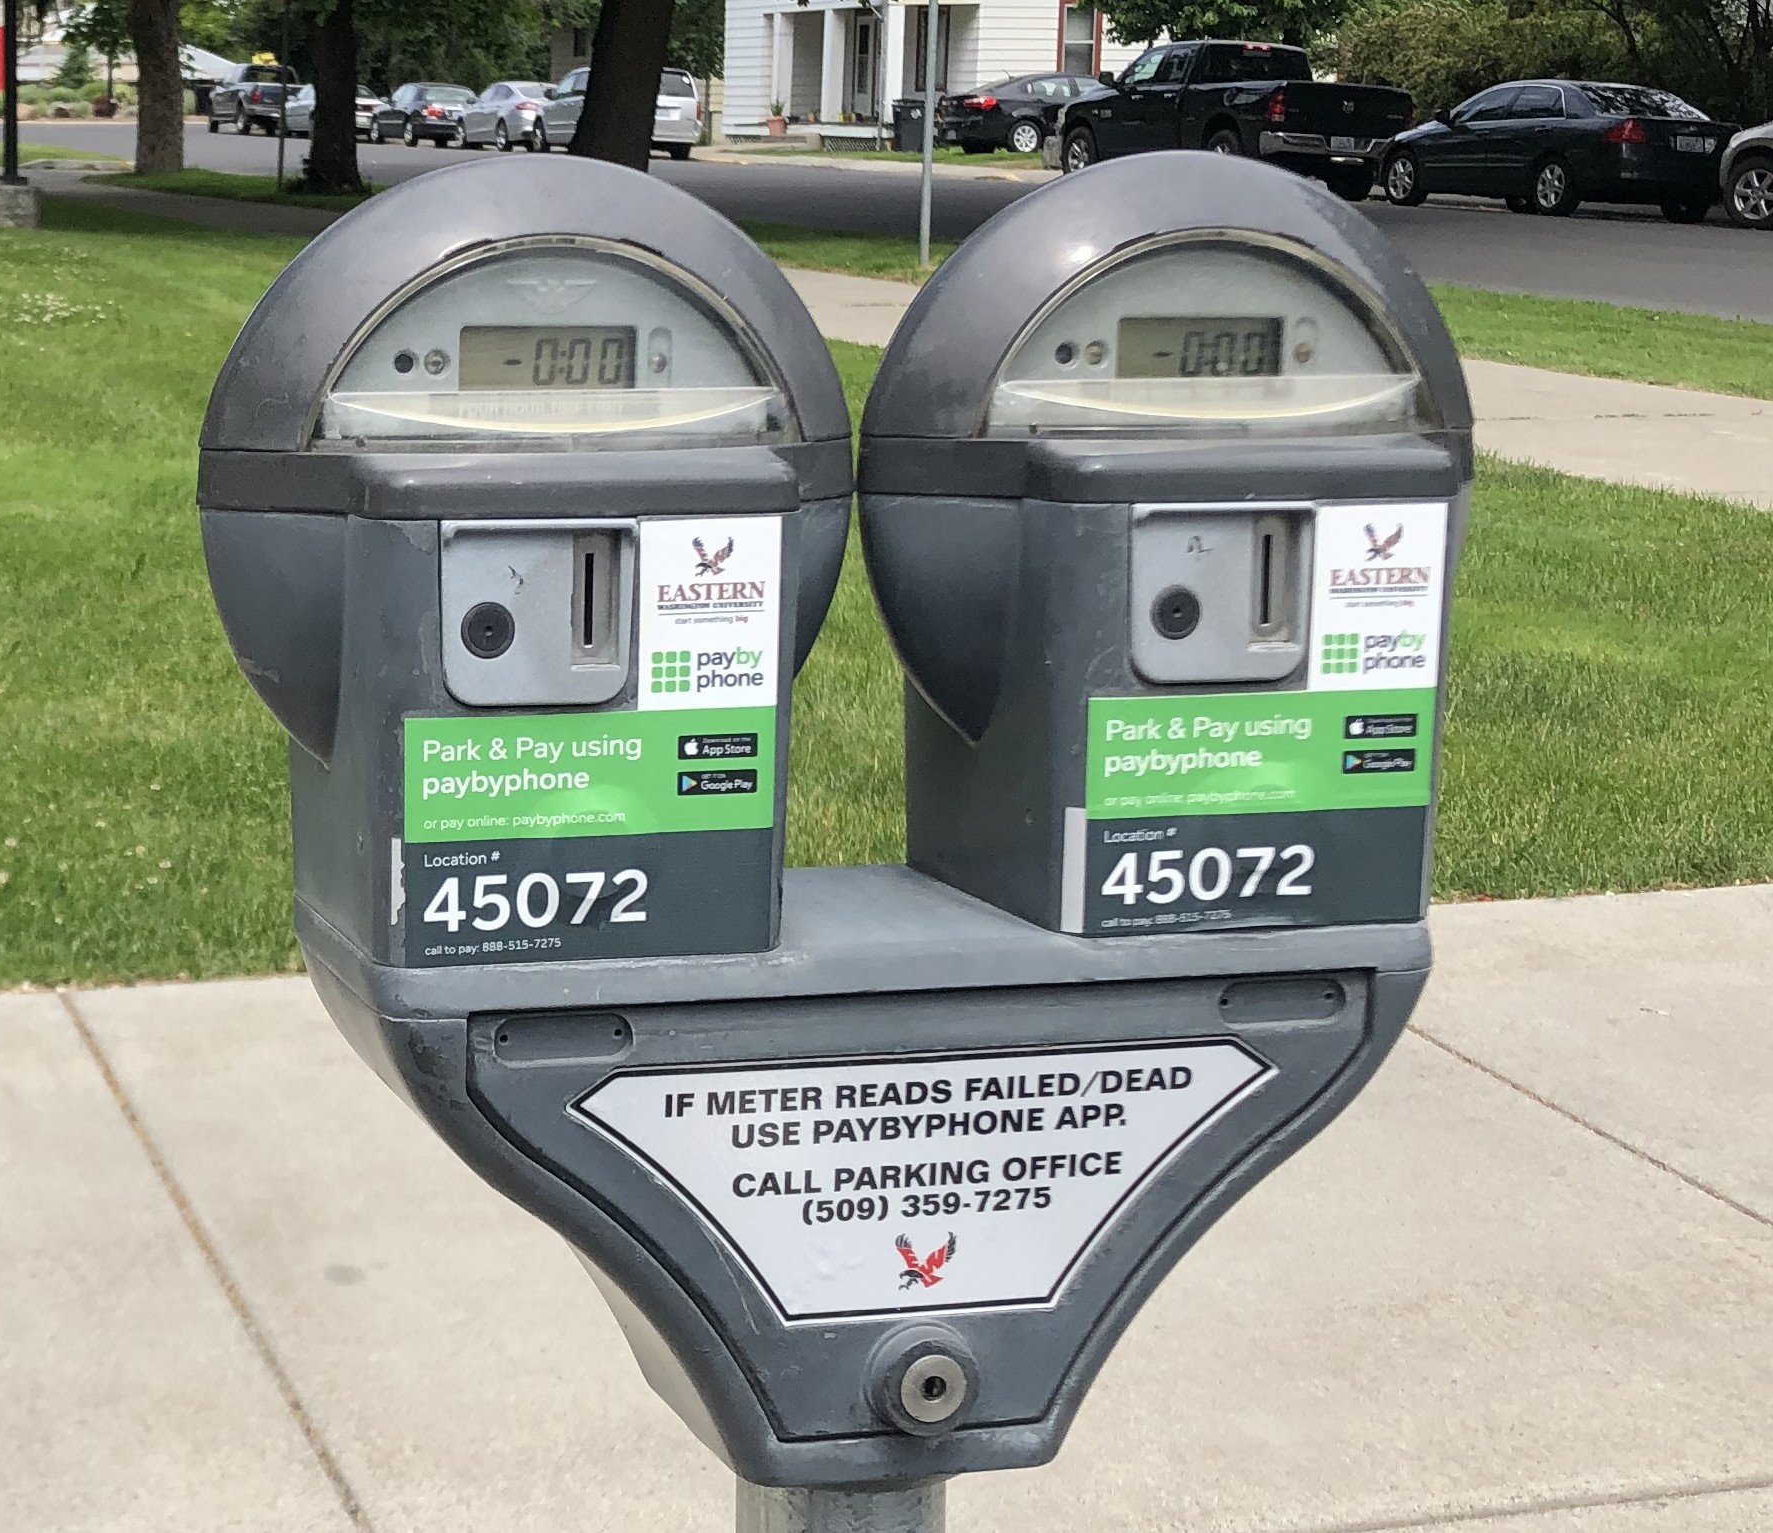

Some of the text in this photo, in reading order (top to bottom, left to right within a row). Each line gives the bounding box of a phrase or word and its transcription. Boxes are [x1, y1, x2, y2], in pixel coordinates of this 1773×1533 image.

[1329, 567, 1431, 586] EASTERN
[657, 581, 765, 602] EASTERN
[697, 646, 763, 670] payby
[1362, 652, 1427, 674] phone
[697, 670, 763, 692] phone
[1106, 714, 1312, 742] Park & Pay using
[423, 734, 642, 763] Park & Pay using
[702, 743, 751, 756] App Store
[1104, 746, 1262, 777] paybyphone
[422, 768, 589, 800] paybyphone
[701, 778, 753, 791] Google Play
[424, 812, 626, 831] or pay online: paybyphone.com
[1103, 828, 1164, 843] Location
[424, 851, 500, 868] Location #
[1101, 844, 1316, 905] 45072
[423, 868, 648, 932] 45072
[424, 943, 442, 956] call
[444, 944, 456, 954] to
[482, 937, 561, 953] 888-515-7275
[664, 1066, 1192, 1118] IF METER READS FAILED/DEAD
[731, 1103, 1126, 1149] USE PAYBYPHONE APP.
[732, 1151, 1123, 1198] CALL PARKING OFFICE
[802, 1186, 1051, 1225] (509) 359-7275
